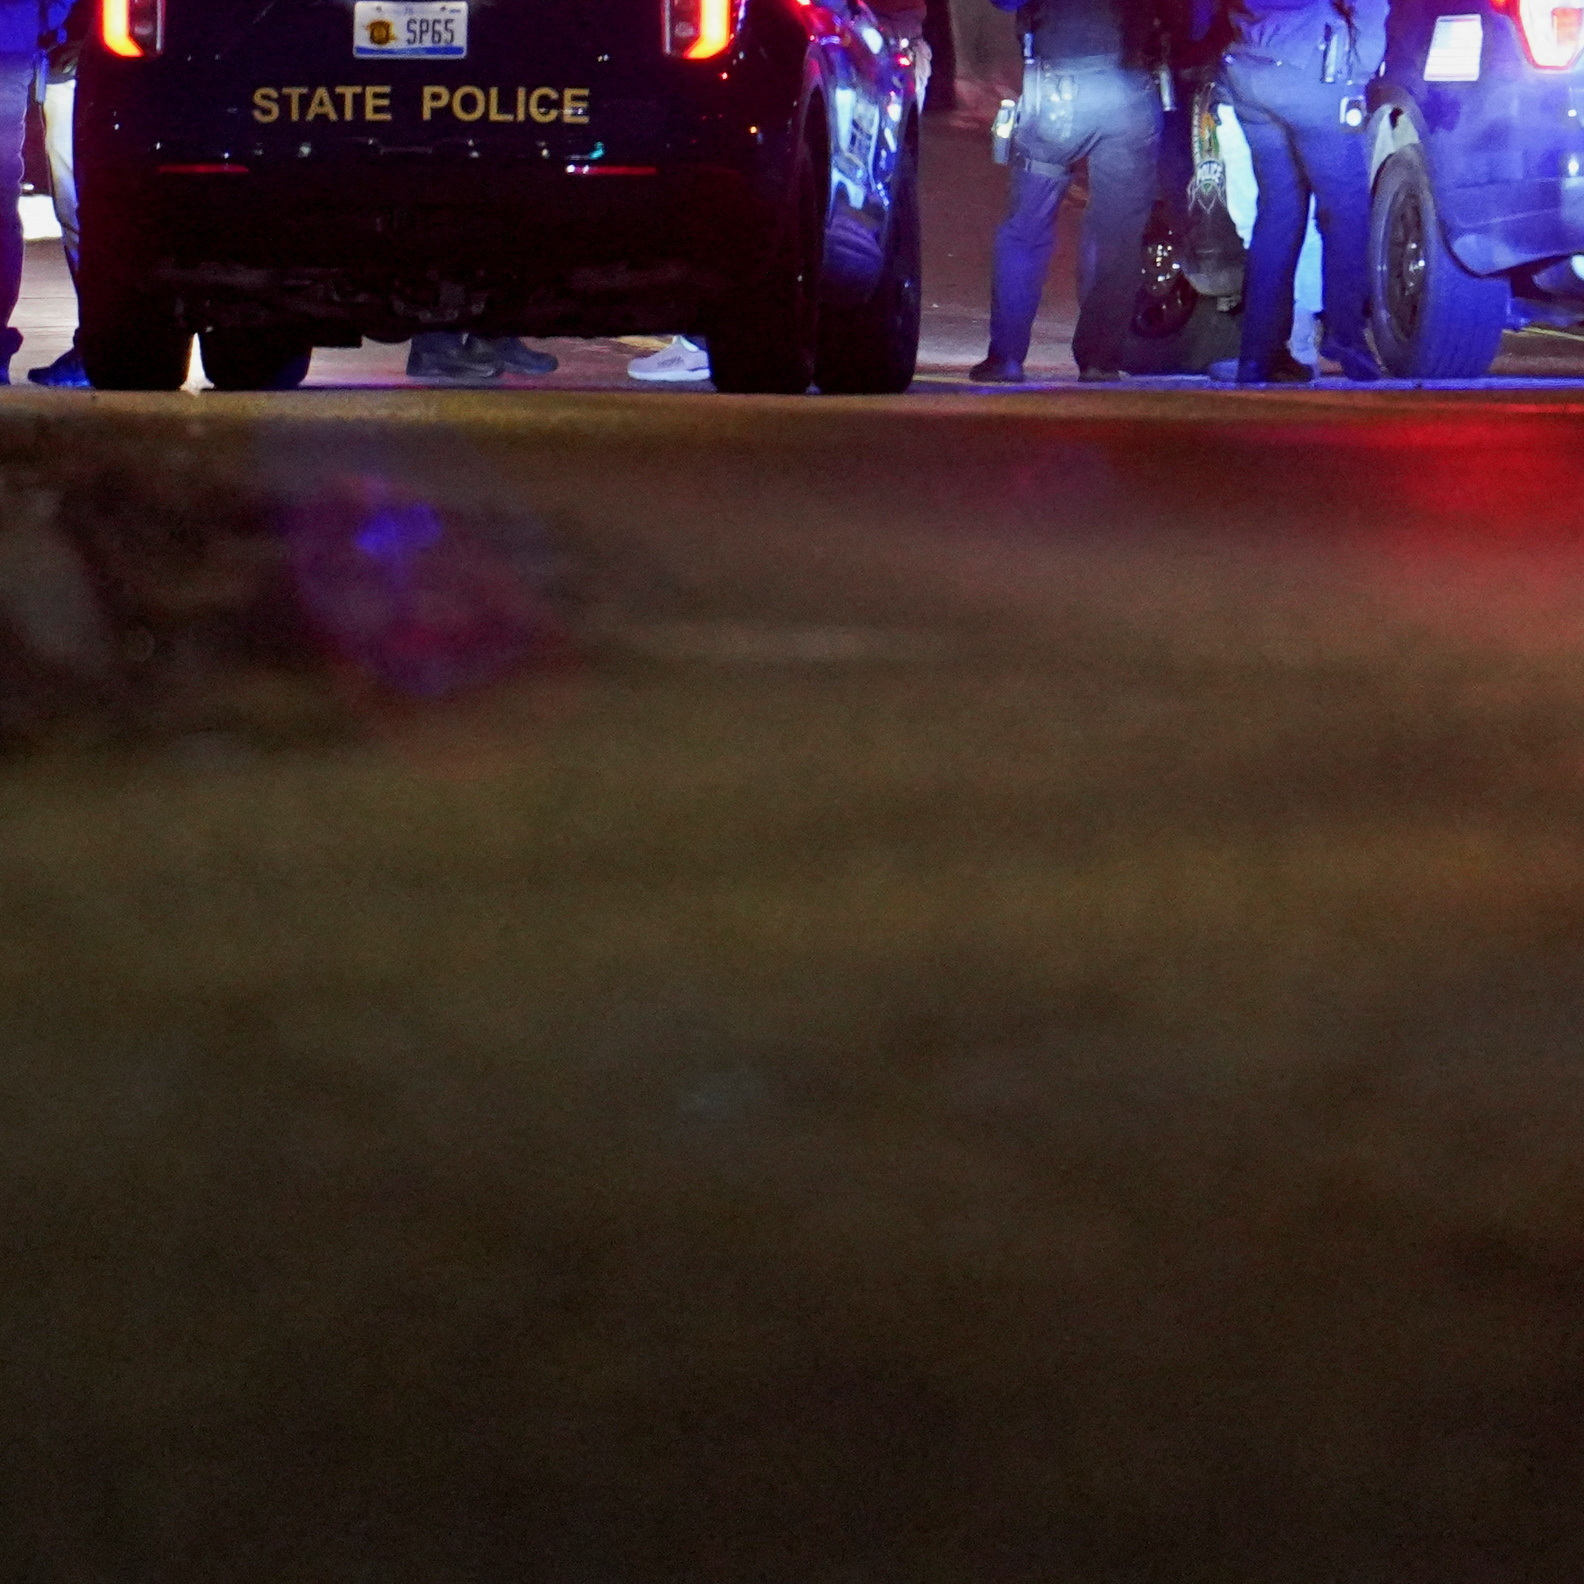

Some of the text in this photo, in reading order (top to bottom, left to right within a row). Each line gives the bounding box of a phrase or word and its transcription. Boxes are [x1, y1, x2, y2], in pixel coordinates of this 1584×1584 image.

[406, 18, 455, 45] SP65
[252, 85, 590, 123] STATE POLICE
